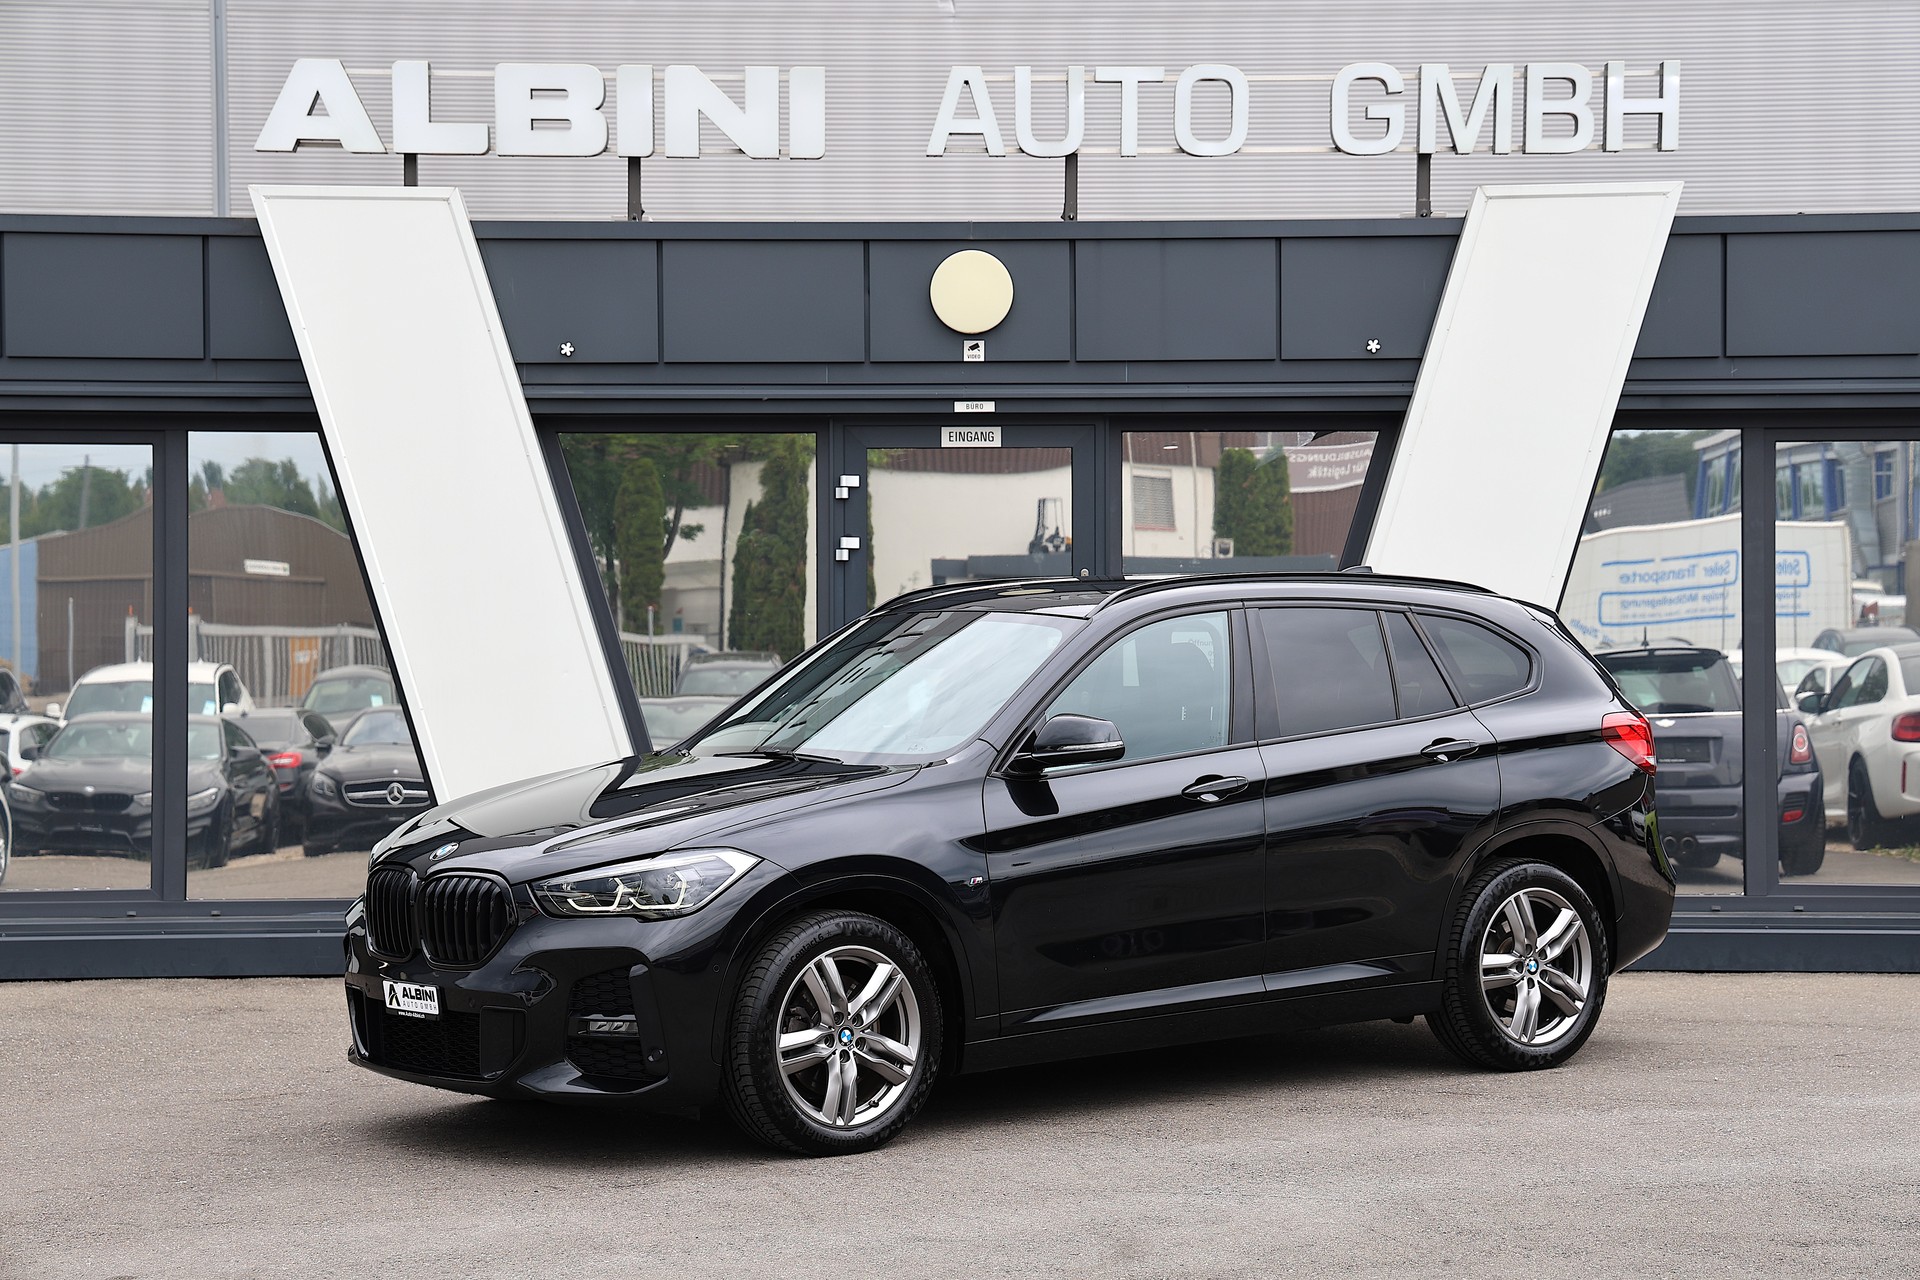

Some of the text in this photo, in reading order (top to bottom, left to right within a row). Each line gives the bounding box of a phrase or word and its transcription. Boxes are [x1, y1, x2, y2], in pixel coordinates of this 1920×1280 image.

[254, 58, 1681, 160] ALBINI AUTO GMBH
[965, 402, 984, 410] BÜRO
[948, 431, 995, 442] EINGANG
[402, 987, 436, 1002] ALBINI
